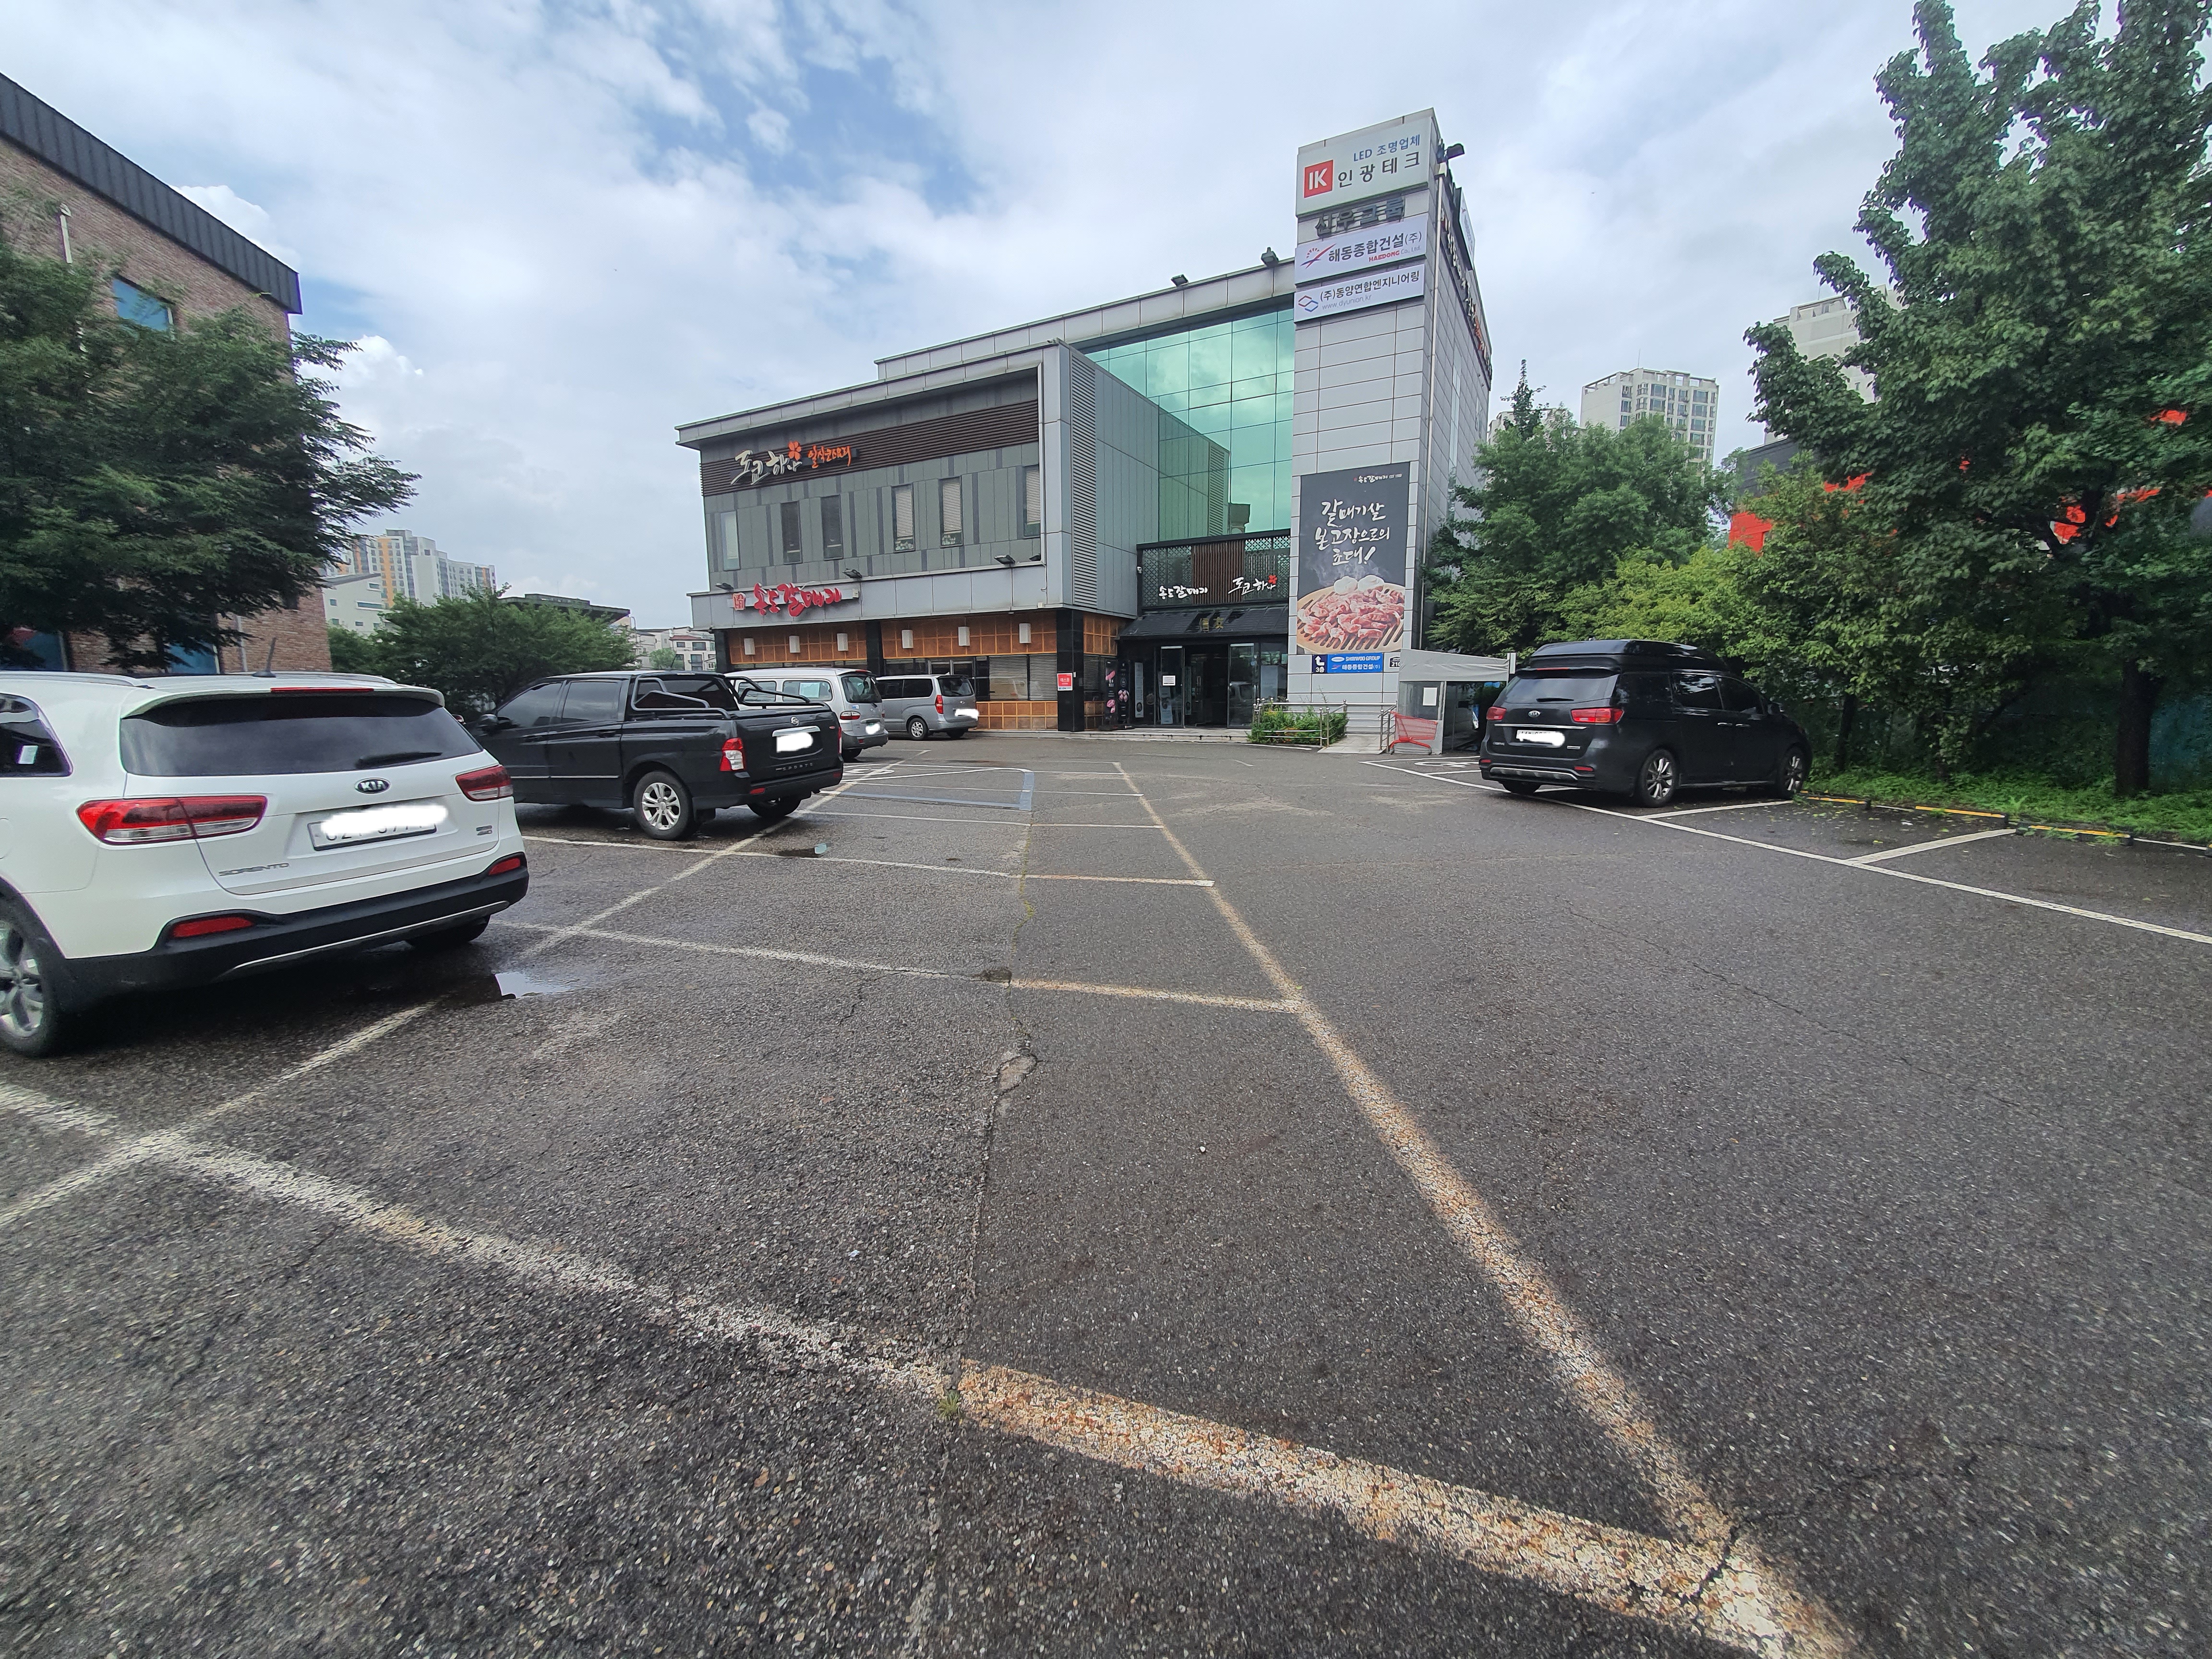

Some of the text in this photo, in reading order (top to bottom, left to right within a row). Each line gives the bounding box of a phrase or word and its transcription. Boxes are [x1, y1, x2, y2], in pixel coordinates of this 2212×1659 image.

[1353, 149, 1372, 162] LED
[1376, 134, 1420, 156] 조명업체
[1309, 168, 1328, 190] IK
[1328, 231, 1422, 262] 해동종합건설(주)
[1369, 250, 1400, 262] HAEDONG
[1320, 270, 1419, 302] (주)동양연합엔지니어링
[1322, 294, 1372, 311] www.dyunion.kr
[1321, 498, 1386, 528] 갈매기살
[1332, 546, 1376, 566] 초대!
[754, 582, 842, 617] 송도갈매기
[1158, 585, 1208, 600] 송도갈매기
[782, 762, 813, 771] SPORTS
[360, 780, 386, 791] KIA
